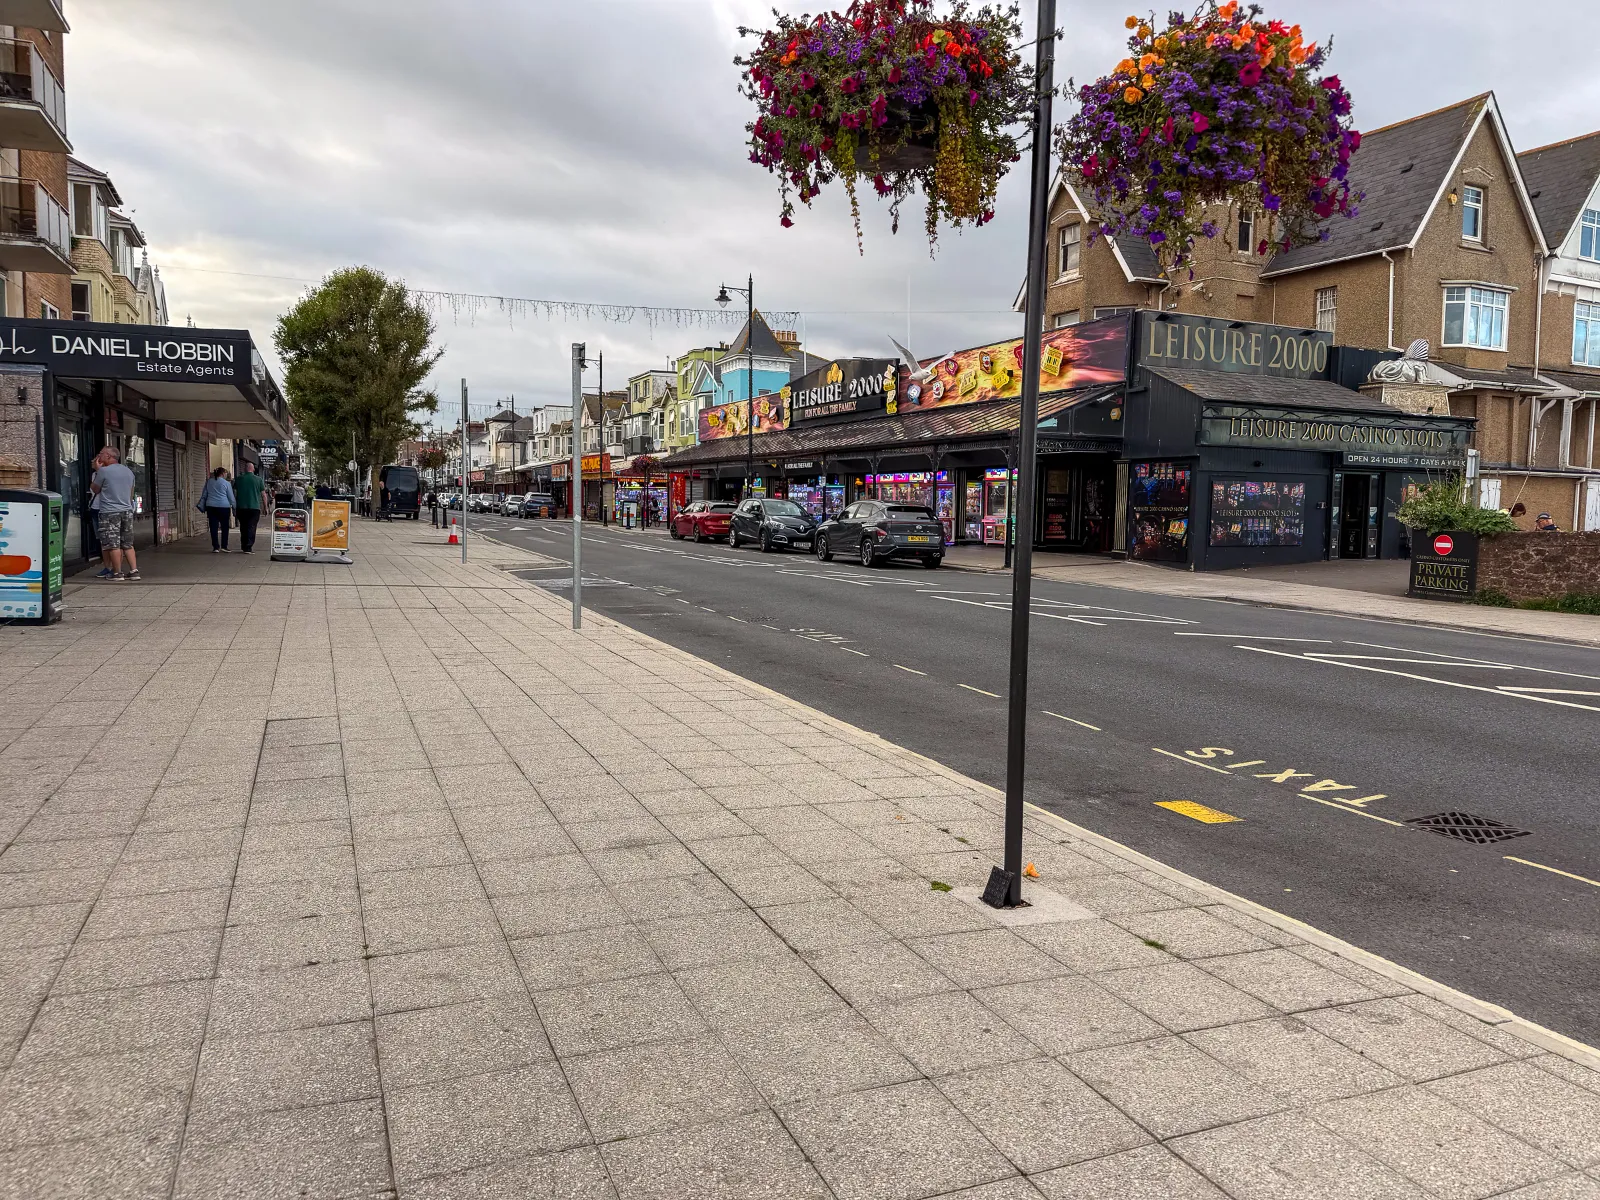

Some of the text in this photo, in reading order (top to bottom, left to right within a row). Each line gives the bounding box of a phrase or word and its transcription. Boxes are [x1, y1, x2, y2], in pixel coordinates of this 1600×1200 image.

[51, 335, 234, 363] DANIEL HOBBIN
[1147, 321, 1327, 373] LEISURE 2000
[137, 361, 234, 376] Estate Agents
[792, 373, 883, 409] LEISURE 2000
[829, 404, 838, 414] THE
[838, 401, 857, 412] FAMILY
[1230, 417, 1444, 448] LEISURE 2000 CASINO SLOTS
[1220, 509, 1243, 517] LEISURE
[1244, 509, 1257, 517] 2000
[1257, 509, 1280, 517] CASINO
[1418, 563, 1467, 578] PRIVATE
[1415, 575, 1469, 590] PARKING
[1185, 747, 1389, 808] TAXIS
